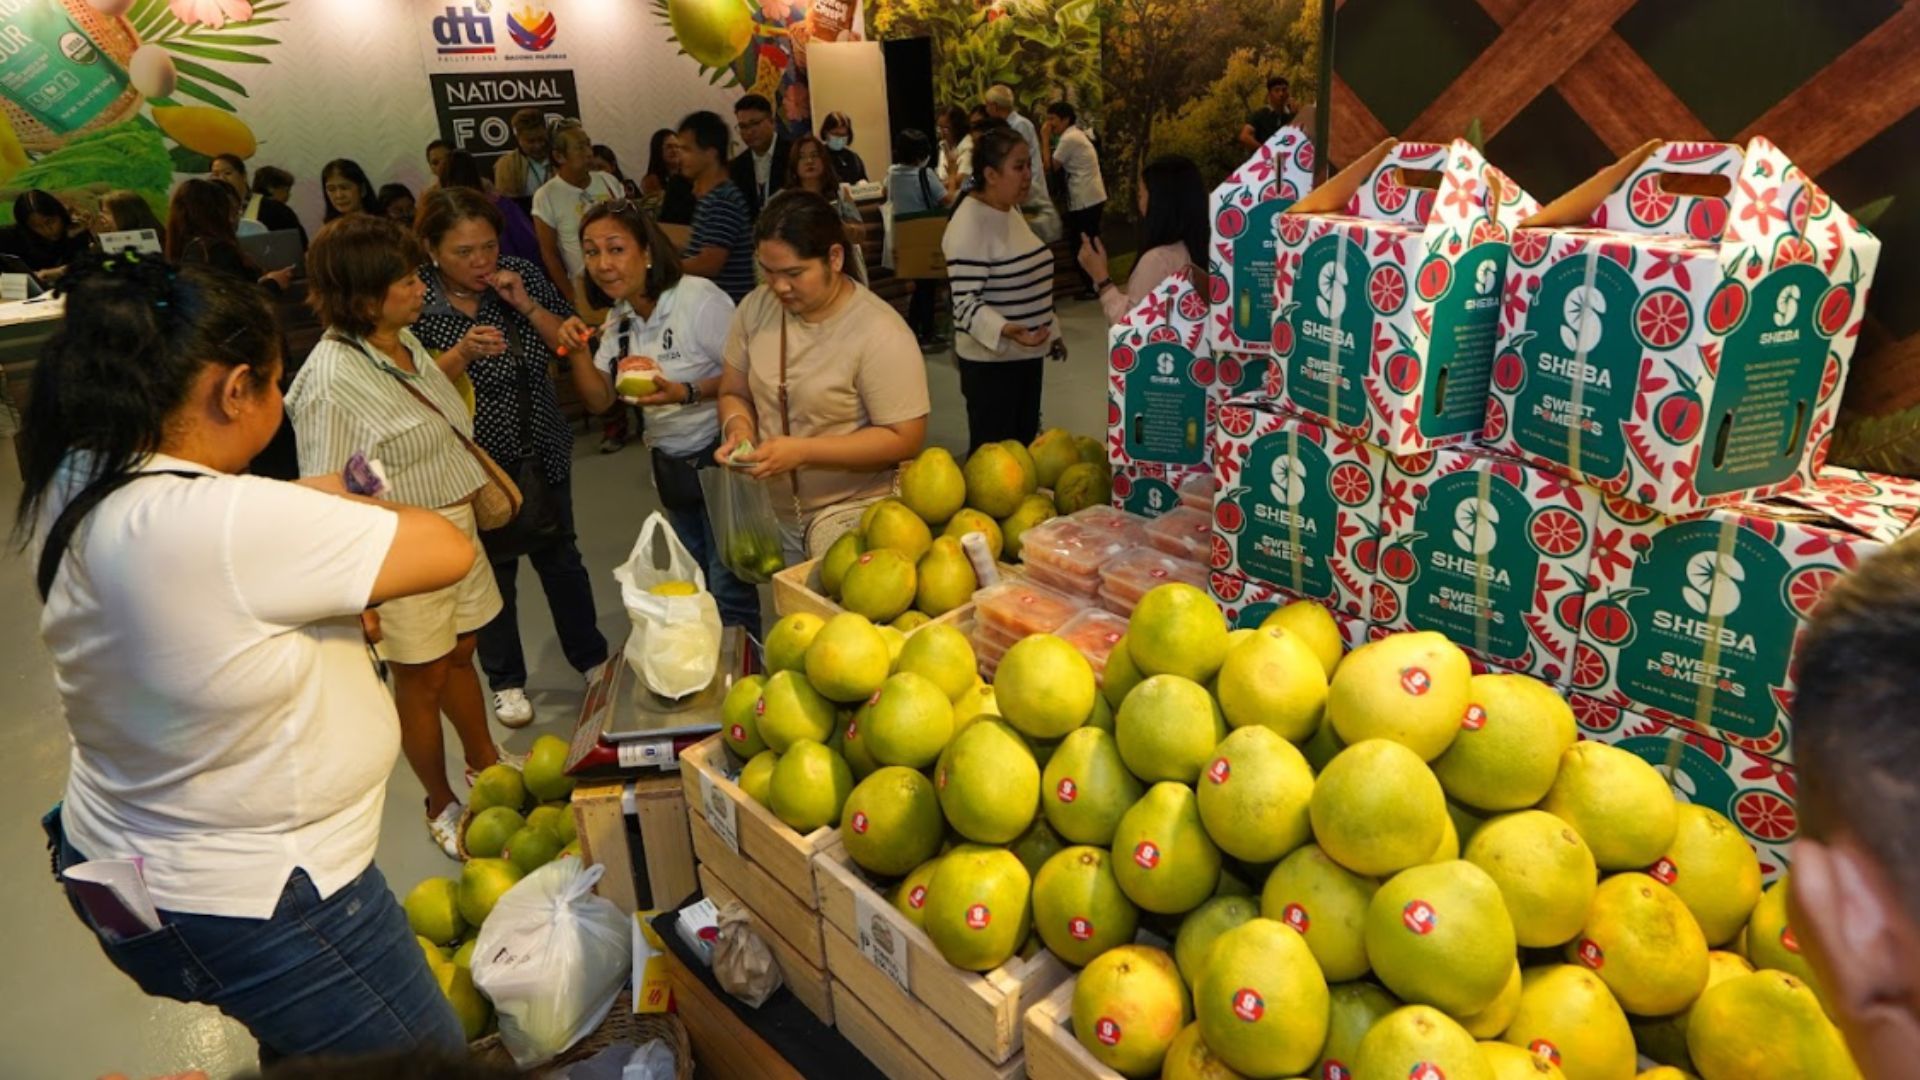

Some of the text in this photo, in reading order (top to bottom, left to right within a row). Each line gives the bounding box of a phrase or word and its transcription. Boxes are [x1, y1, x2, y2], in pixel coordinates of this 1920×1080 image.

[432, 2, 494, 45] dti
[445, 78, 562, 103] NATIONAL
[453, 113, 565, 149] FO
[1464, 297, 1499, 311] SHEBA
[1302, 319, 1356, 349] SHEBA
[1759, 329, 1800, 345] SHEBA
[1300, 364, 1351, 391] POMELOS
[1306, 356, 1345, 375] SWEET
[1537, 352, 1613, 389] SHEBA
[1150, 375, 1180, 385] SHEBA
[1542, 394, 1596, 418] SWEET
[1532, 404, 1604, 437] POMELOS
[1254, 503, 1318, 534] SHEBA
[1254, 542, 1315, 568] POMELOS
[1261, 535, 1307, 554] SWEET
[1734, 538, 1767, 562] UALITY
[1430, 551, 1511, 587] SHEBA
[1429, 594, 1505, 625] POMELOS
[1439, 587, 1497, 609] SWEET
[1652, 610, 1758, 654] SHEBA
[1646, 659, 1746, 698] POMELOS
[1661, 651, 1736, 679] SWEET
[1710, 704, 1757, 725] OTABATO
